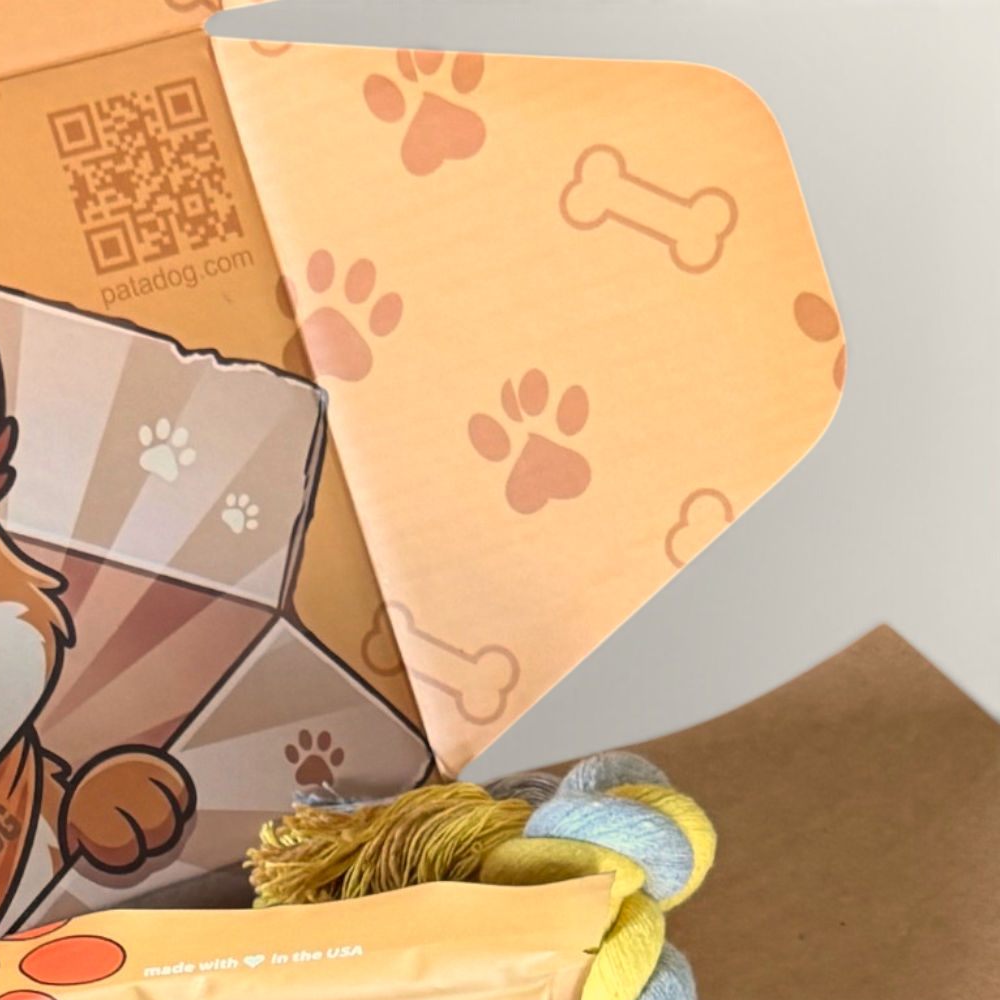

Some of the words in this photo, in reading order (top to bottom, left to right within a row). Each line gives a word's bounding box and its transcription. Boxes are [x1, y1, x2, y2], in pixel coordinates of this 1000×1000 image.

[101, 249, 255, 310] patadog.com
[143, 961, 196, 977] made
[198, 957, 239, 972] with
[271, 952, 289, 964] in
[292, 949, 323, 963] the
[326, 945, 364, 960] USA
